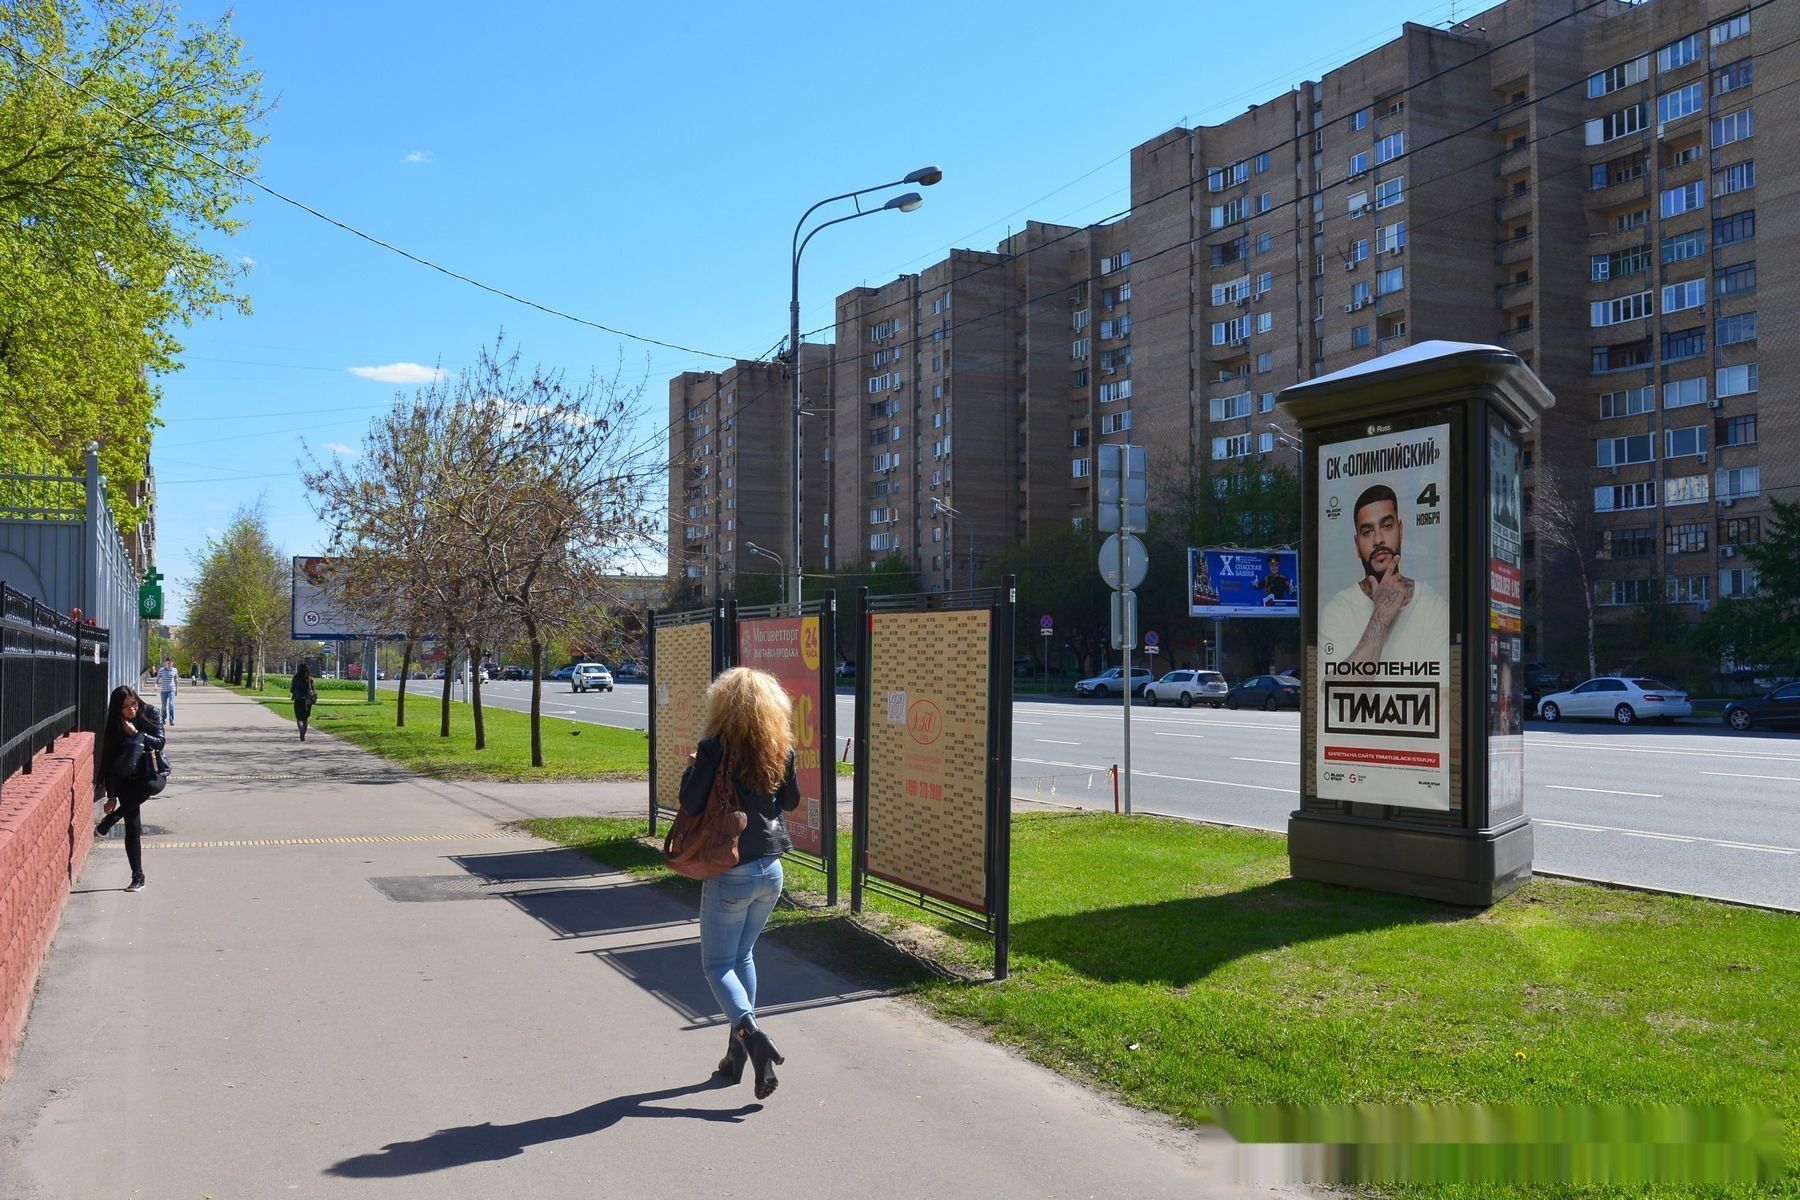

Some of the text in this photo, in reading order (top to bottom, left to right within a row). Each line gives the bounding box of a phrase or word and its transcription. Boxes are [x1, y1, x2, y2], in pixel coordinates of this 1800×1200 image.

[1326, 437, 1440, 480] СК «ОЛИМПИЙСКИЙ»
[1416, 482, 1440, 507] 4
[1416, 511, 1440, 526] НОЯБРЯ
[753, 627, 799, 644] Мосцветторг
[805, 627, 817, 648] 24
[753, 648, 799, 658] ВЫСТАВКА-ПРОДАЖА
[1325, 661, 1440, 675] ПОКОЛЕНИЕ
[1333, 692, 1430, 726] ТИМАТИ
